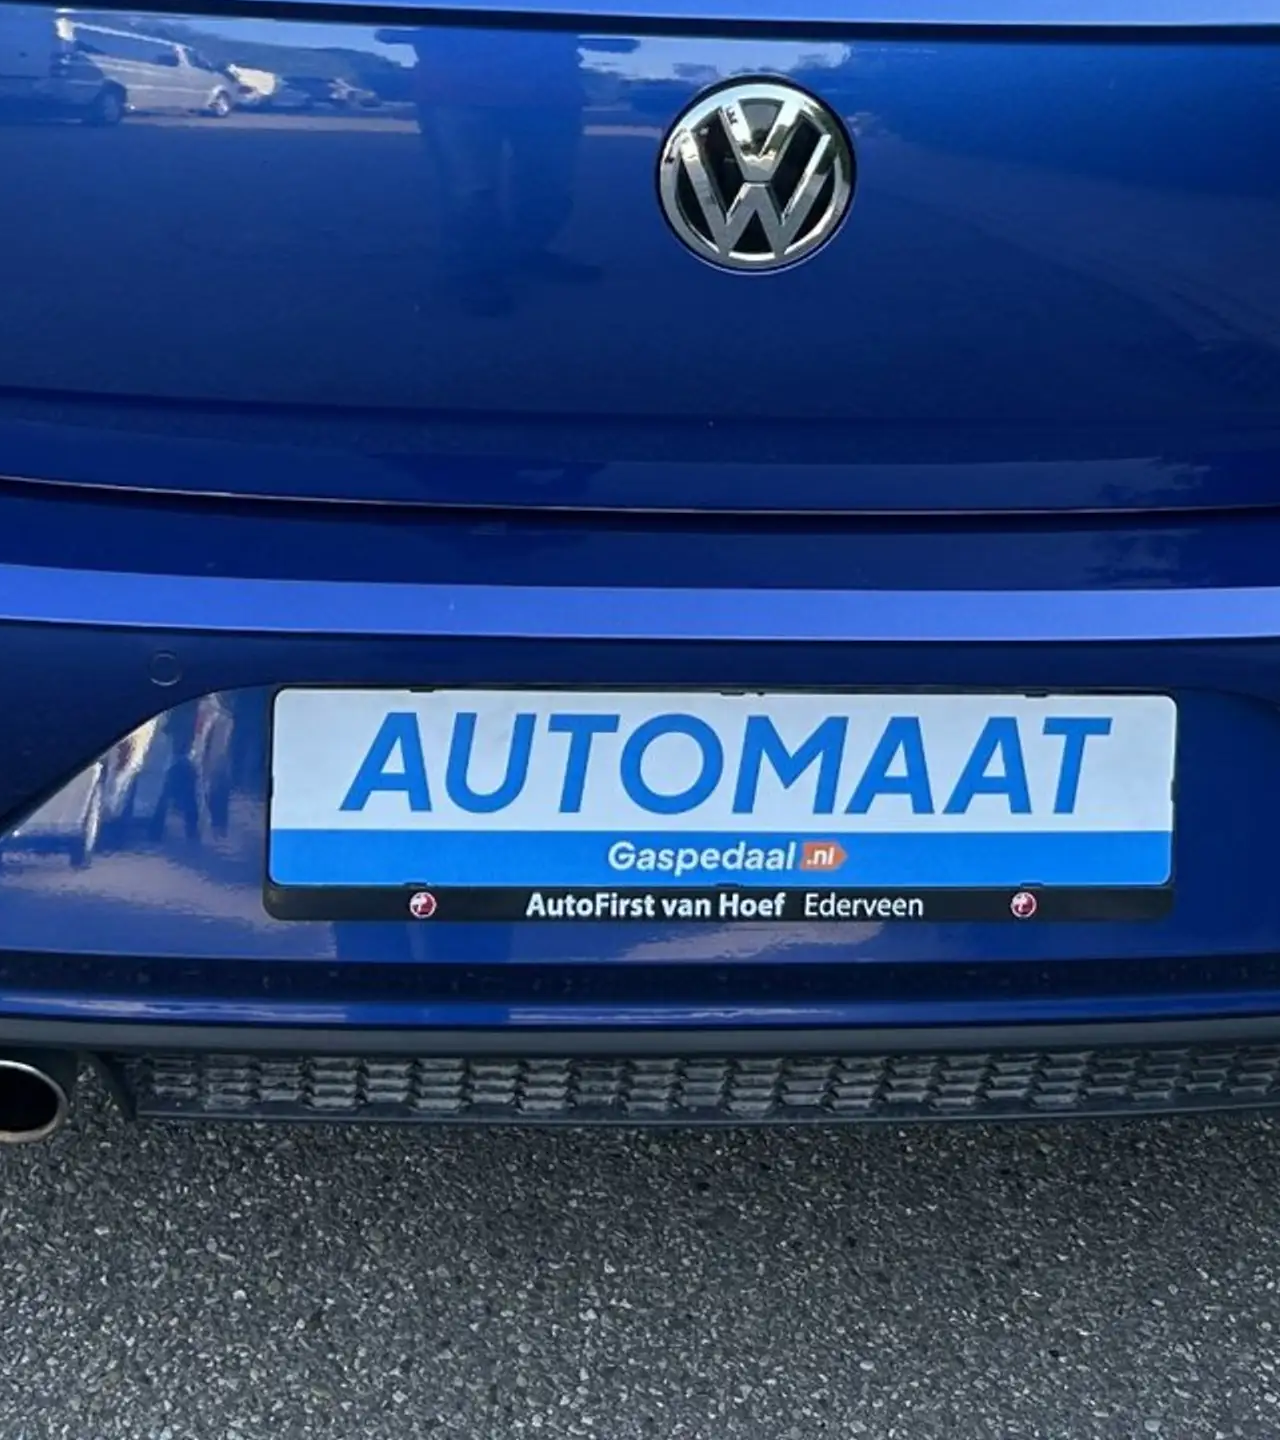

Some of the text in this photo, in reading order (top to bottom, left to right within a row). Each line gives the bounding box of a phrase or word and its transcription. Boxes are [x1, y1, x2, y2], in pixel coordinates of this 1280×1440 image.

[338, 711, 1113, 815] AUTOMAAT
[526, 891, 924, 918] AutoFirst van Hoef Ederveen
